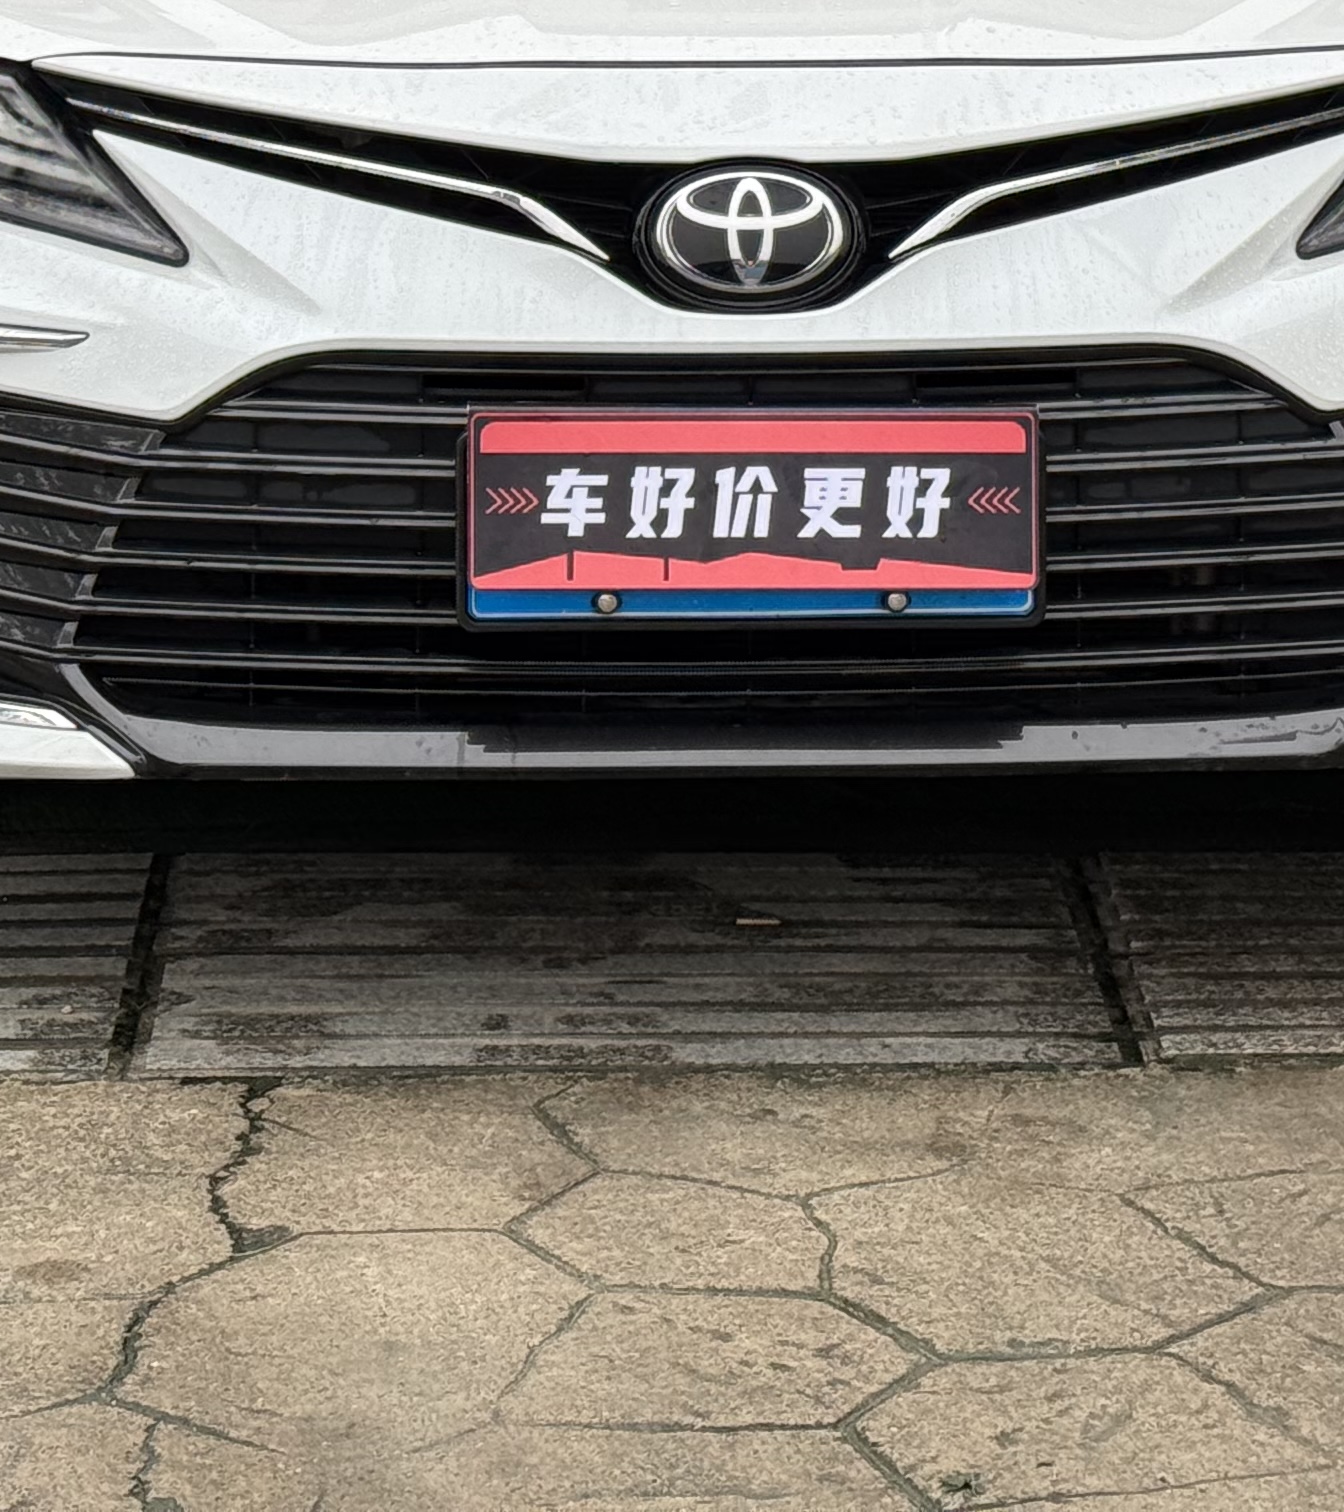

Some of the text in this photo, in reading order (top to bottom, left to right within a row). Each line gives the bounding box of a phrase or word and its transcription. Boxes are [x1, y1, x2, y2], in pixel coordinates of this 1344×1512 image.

[539, 465, 952, 539] 车好价更好
